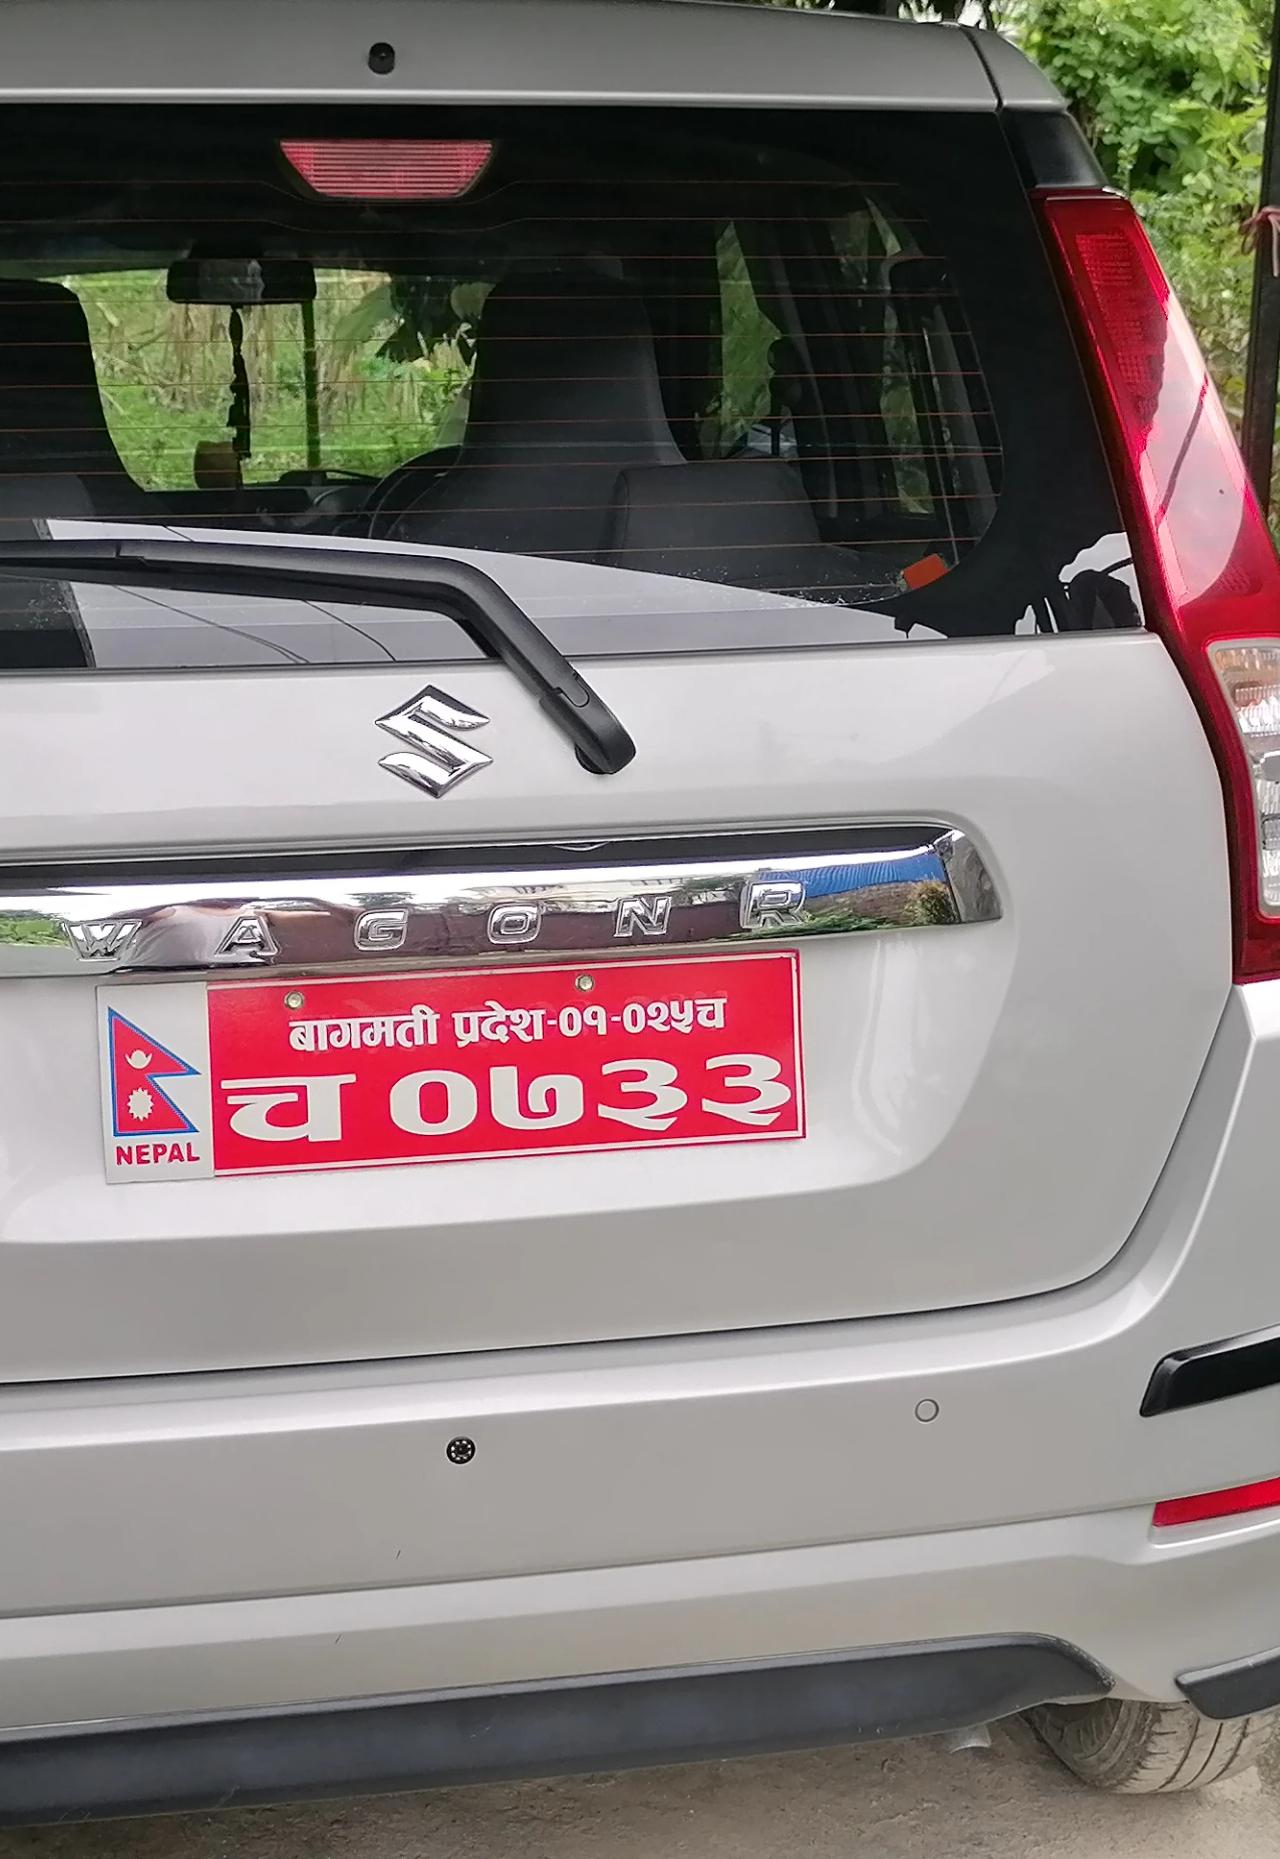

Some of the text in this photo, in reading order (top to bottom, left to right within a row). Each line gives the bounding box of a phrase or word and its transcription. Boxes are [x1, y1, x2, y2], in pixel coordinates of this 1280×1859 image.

[289, 1003, 440, 1051] बागमती
[220, 1054, 792, 1142] च ०७३३
[116, 1142, 201, 1166] NEPAL
